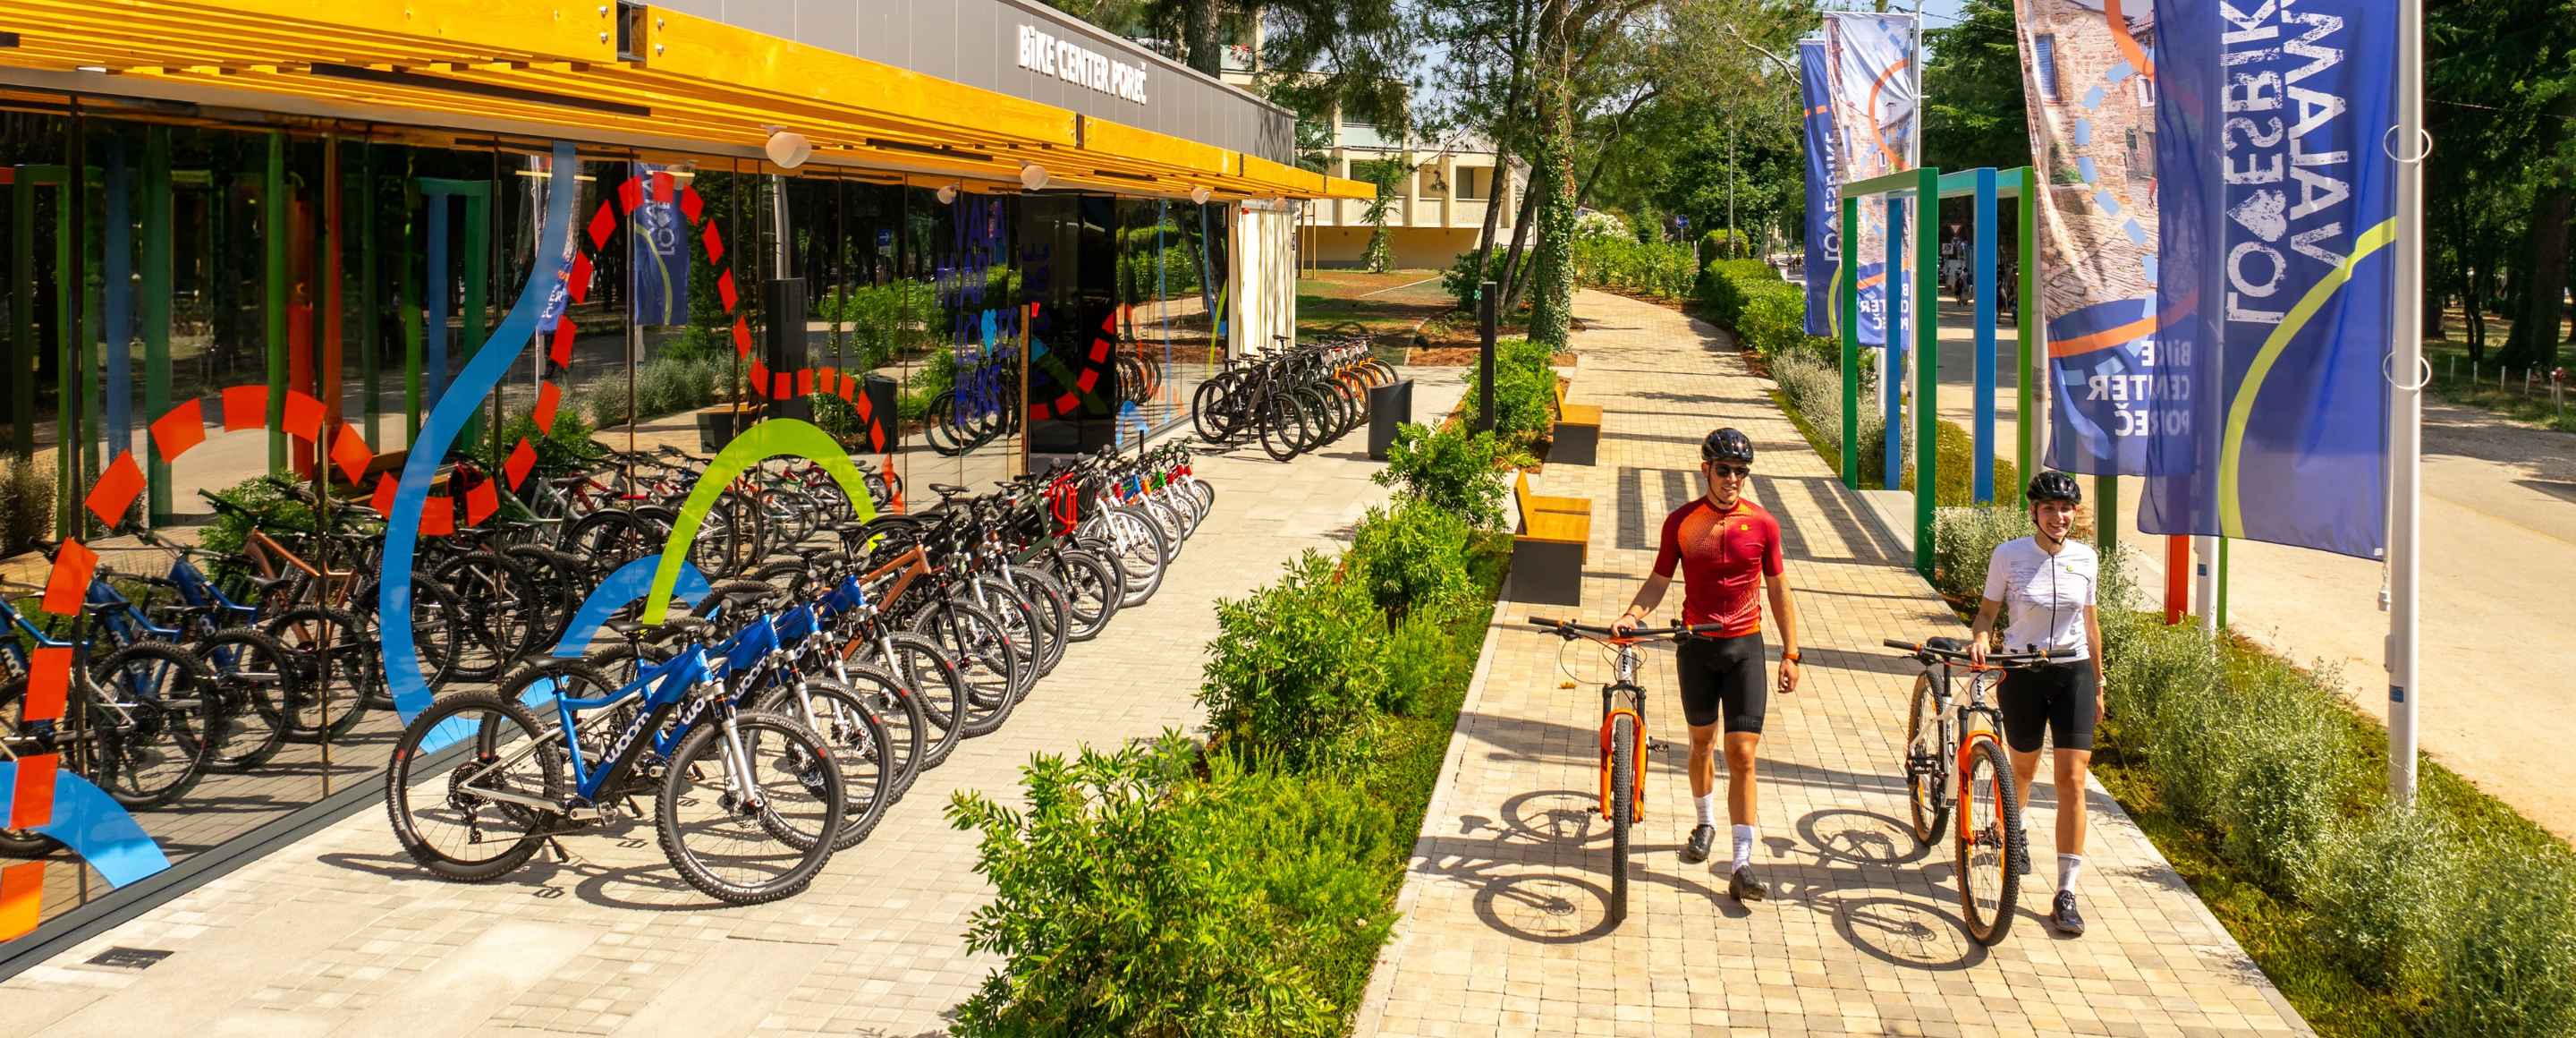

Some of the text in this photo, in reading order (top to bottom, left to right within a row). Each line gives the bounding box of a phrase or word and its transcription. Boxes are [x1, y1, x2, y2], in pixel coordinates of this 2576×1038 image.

[1055, 39, 1110, 94] CENTER
[1111, 59, 1148, 106] POREČ
[605, 711, 651, 763] woom
[757, 716, 820, 748] SCHWALBE
